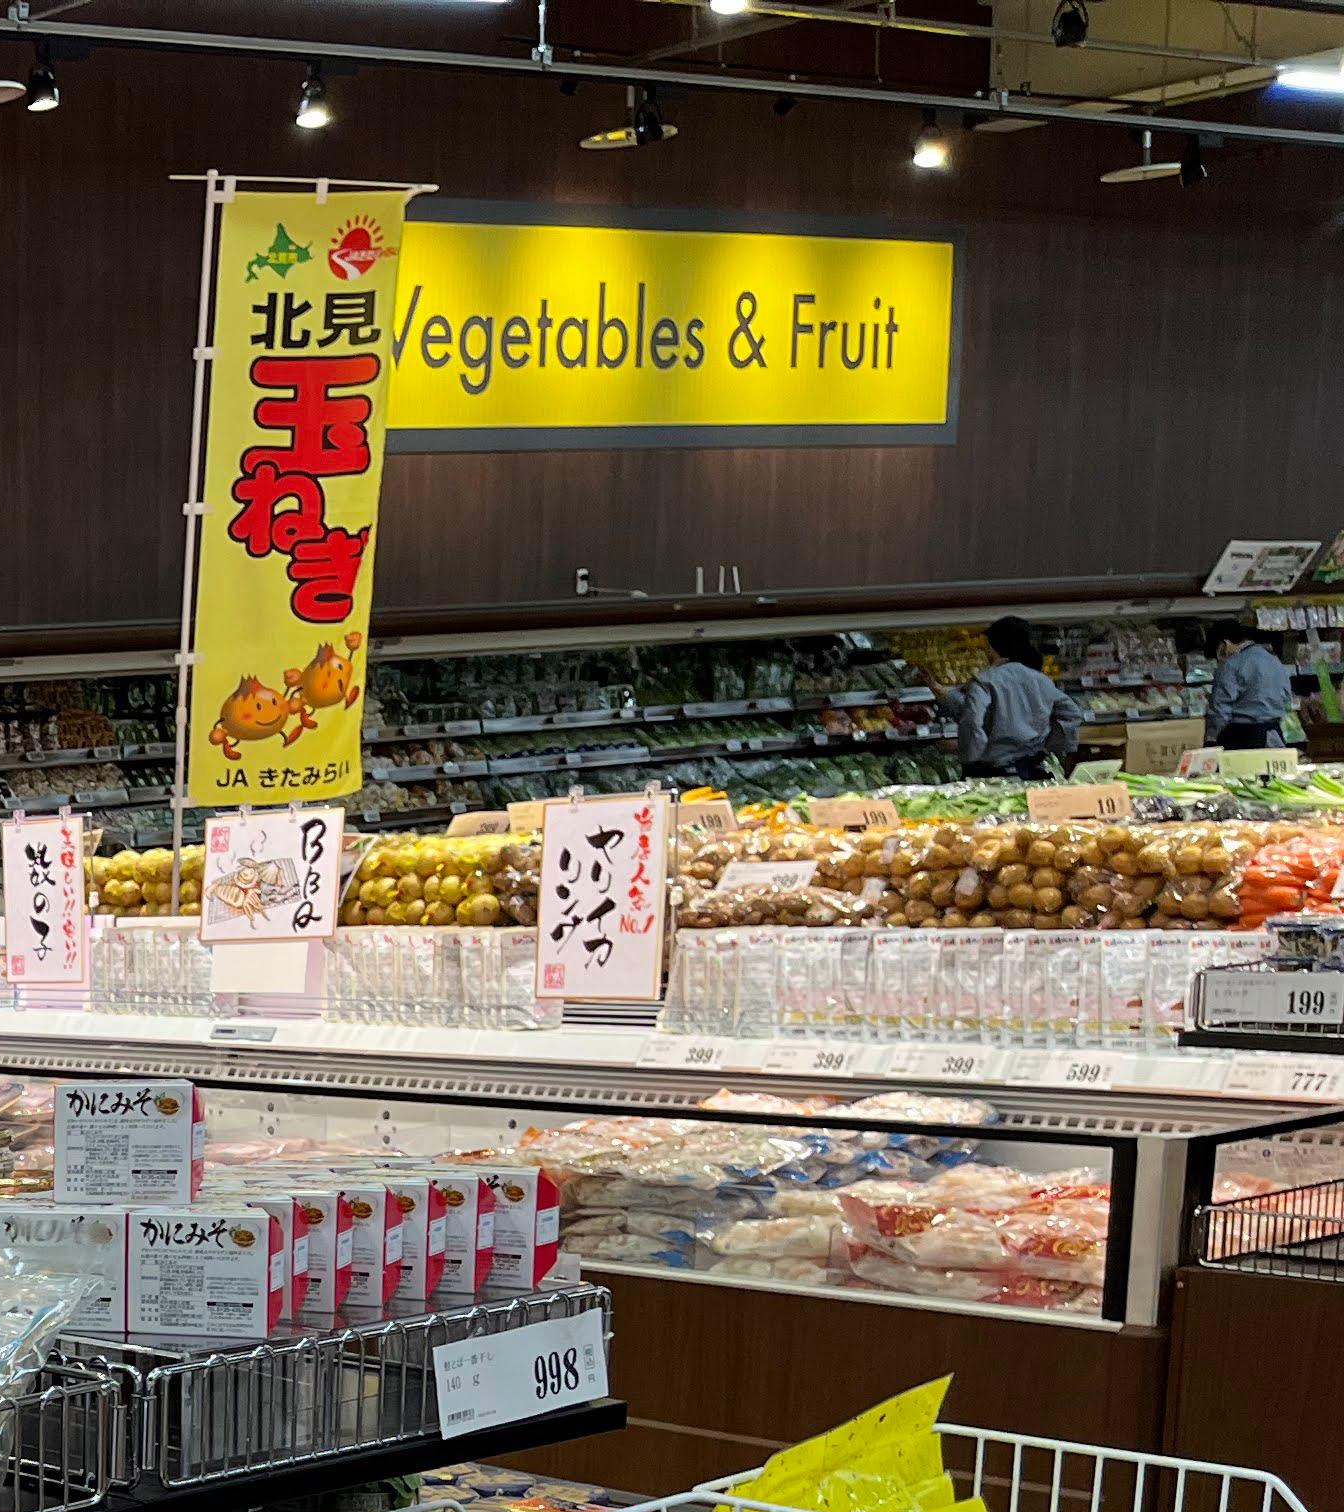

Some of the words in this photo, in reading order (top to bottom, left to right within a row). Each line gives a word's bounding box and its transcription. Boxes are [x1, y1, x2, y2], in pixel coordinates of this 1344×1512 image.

[251, 290, 380, 349] 北見
[391, 282, 705, 396] Vegetables
[729, 291, 767, 369] &
[790, 294, 899, 370] Fruit
[228, 353, 380, 623] 玉ねぎ
[216, 768, 248, 788] JA
[258, 761, 350, 788] きたみらい
[24, 841, 57, 962] 数の子
[549, 847, 584, 955] リング
[583, 824, 624, 970] ヤリイカ
[1287, 990, 1325, 1014] 199
[684, 1047, 714, 1064] 399
[813, 1052, 845, 1070] 399
[941, 1056, 975, 1075] 399
[1064, 1063, 1102, 1083] 599
[1290, 1071, 1329, 1092] 777
[66, 1088, 153, 1117] かにみそ
[140, 1218, 227, 1248] かにみそ
[446, 1376, 461, 1392] 140
[534, 1347, 579, 1399] 998
